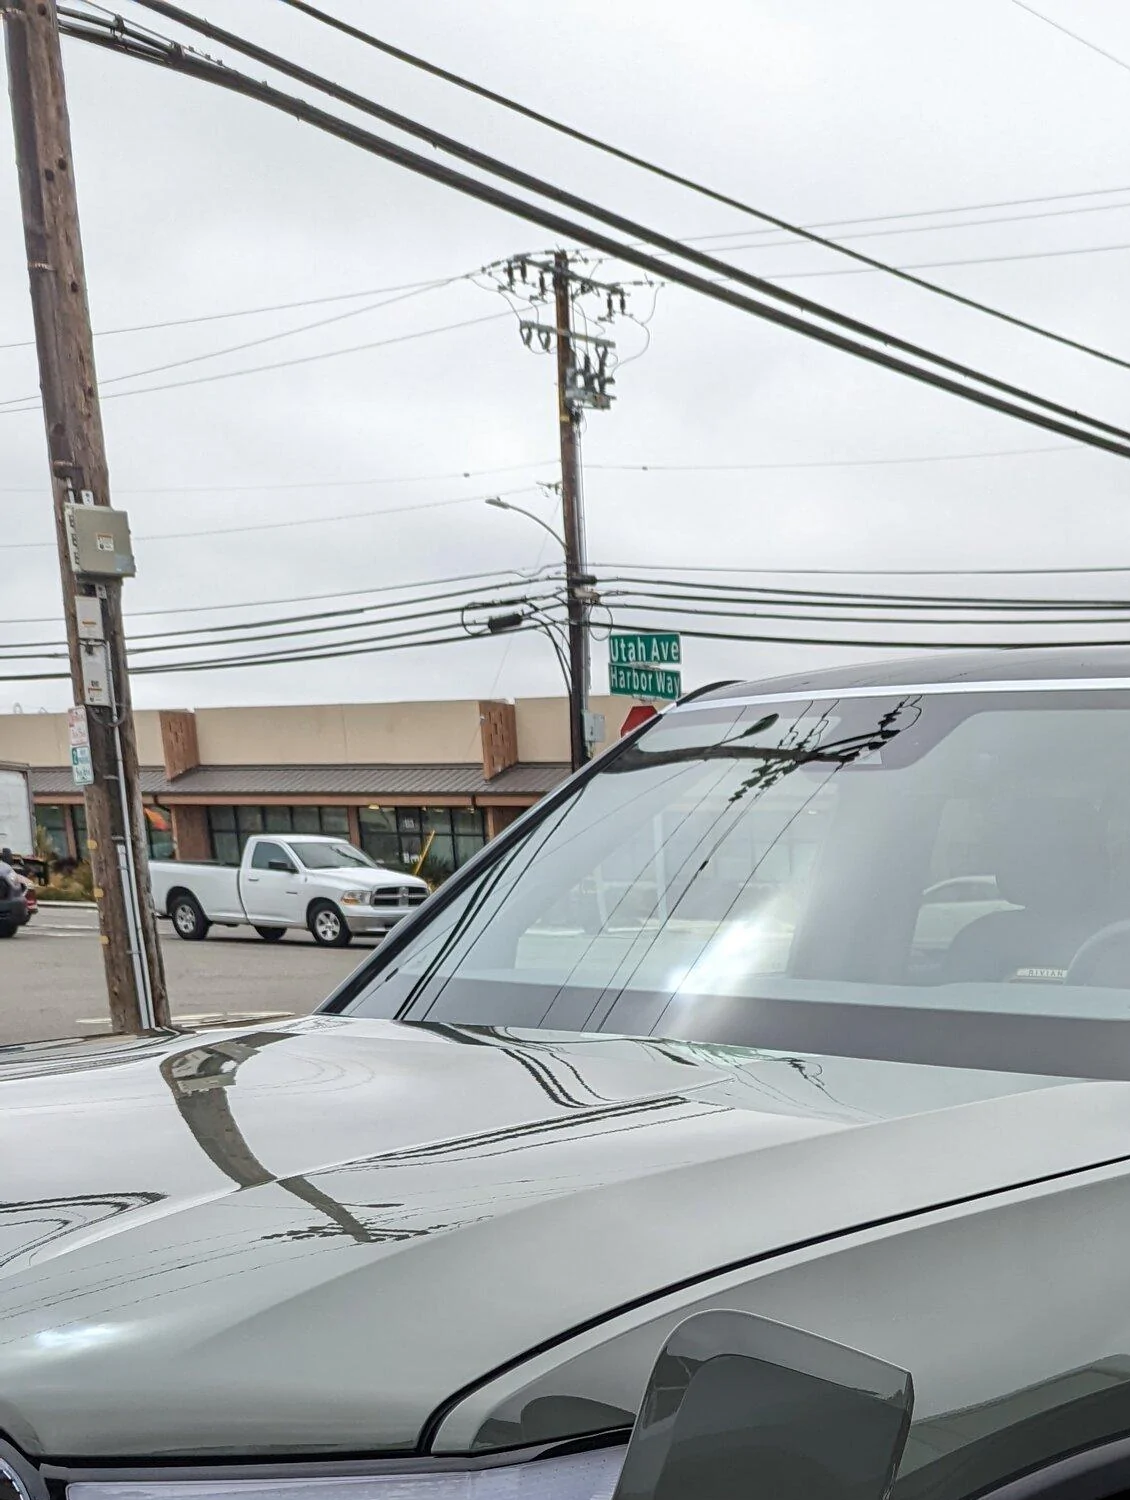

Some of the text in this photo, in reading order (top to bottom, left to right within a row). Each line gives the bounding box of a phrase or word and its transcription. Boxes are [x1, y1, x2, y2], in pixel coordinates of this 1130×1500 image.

[611, 637, 678, 662] Utah Ave
[611, 666, 680, 699] Harbor Way
